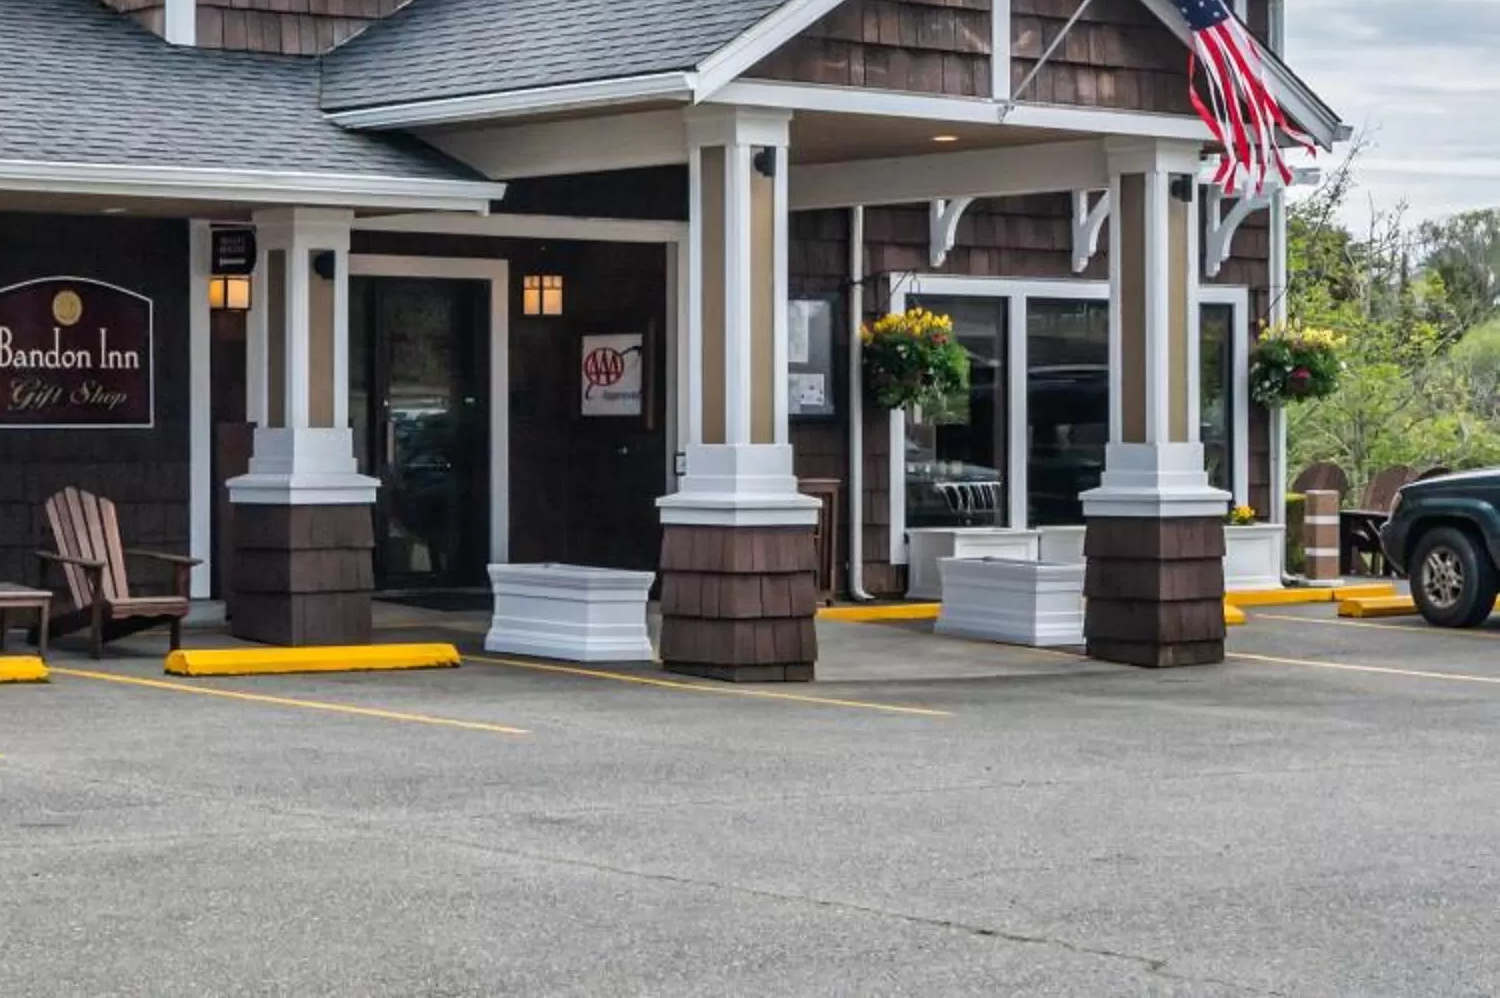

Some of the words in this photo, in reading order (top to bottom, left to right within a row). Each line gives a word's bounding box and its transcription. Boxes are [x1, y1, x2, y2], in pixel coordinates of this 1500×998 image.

[99, 328, 140, 369] Inn
[585, 348, 623, 385] AAA
[8, 379, 64, 410] Gift
[70, 378, 128, 410] Shop
